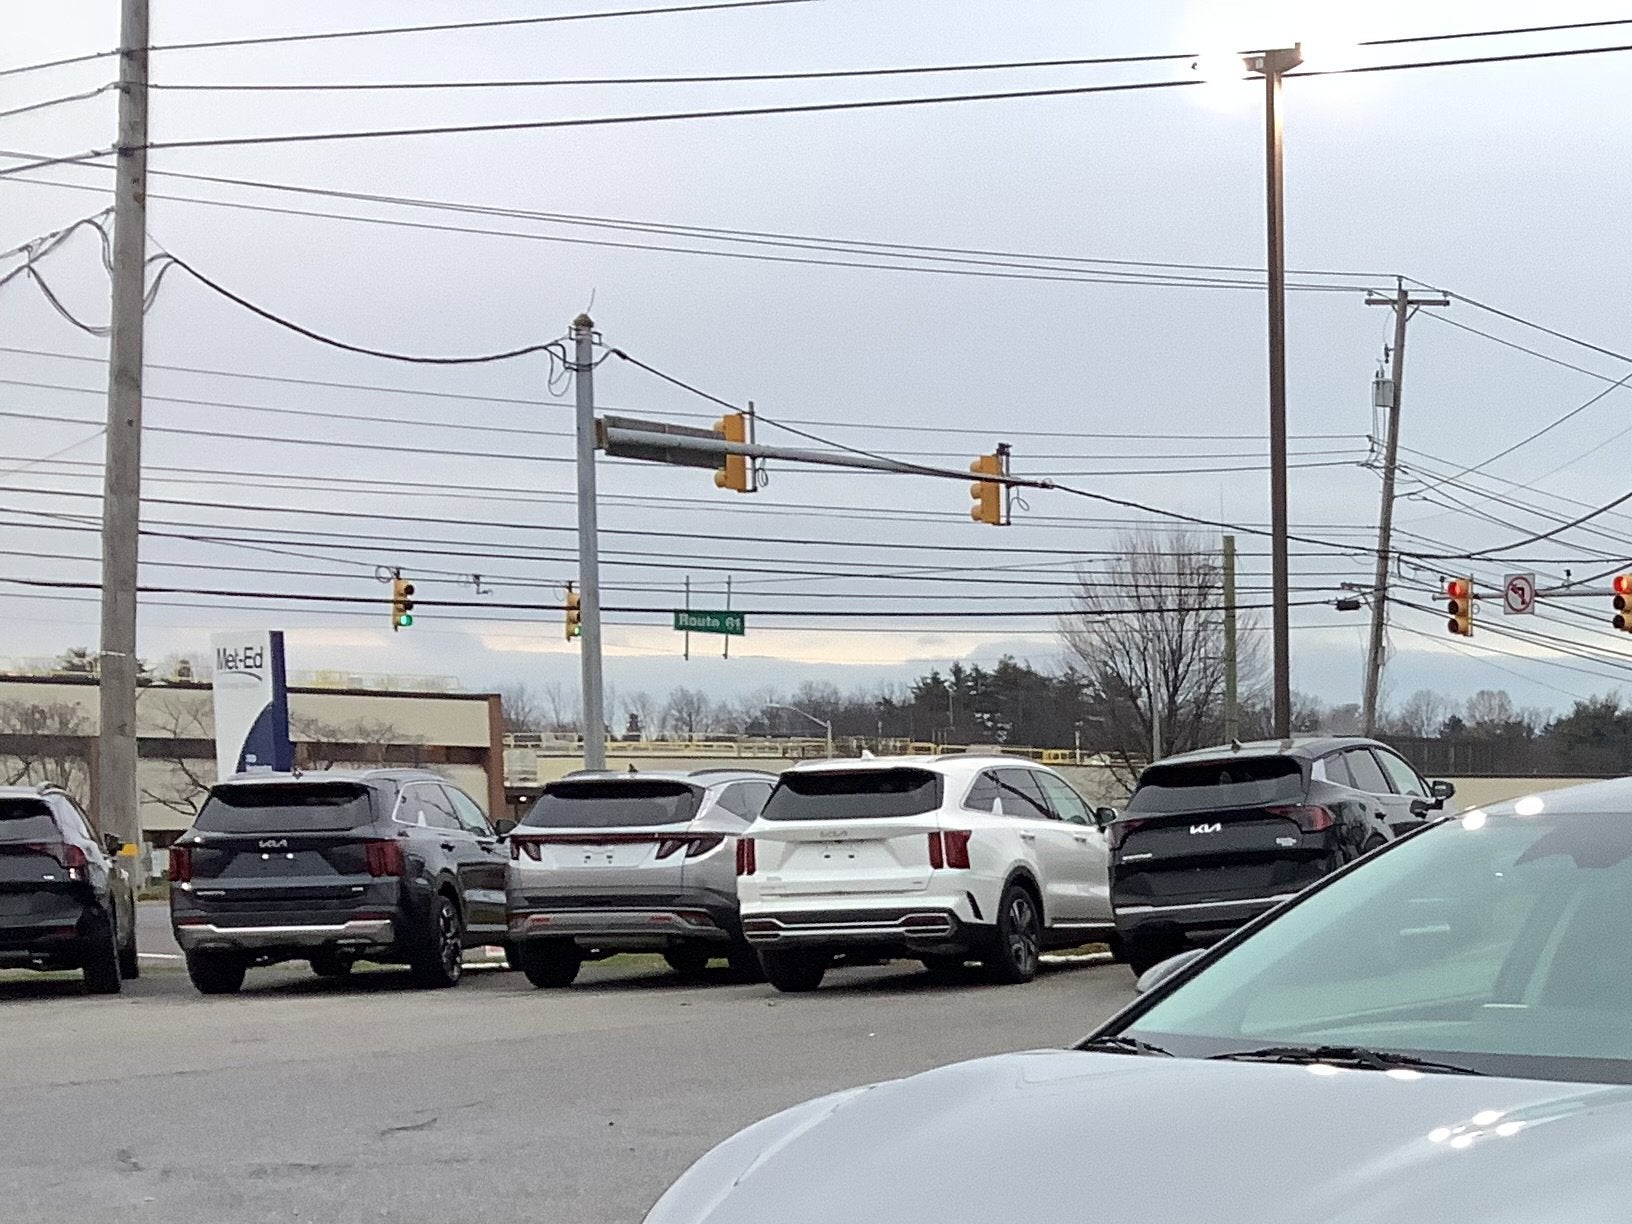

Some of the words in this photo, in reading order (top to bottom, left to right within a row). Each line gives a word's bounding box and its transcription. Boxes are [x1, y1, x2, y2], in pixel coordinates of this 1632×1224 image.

[679, 613, 720, 627] Route
[725, 616, 741, 631] 61
[216, 646, 263, 670] Met-Ed
[1190, 823, 1222, 834] KIA
